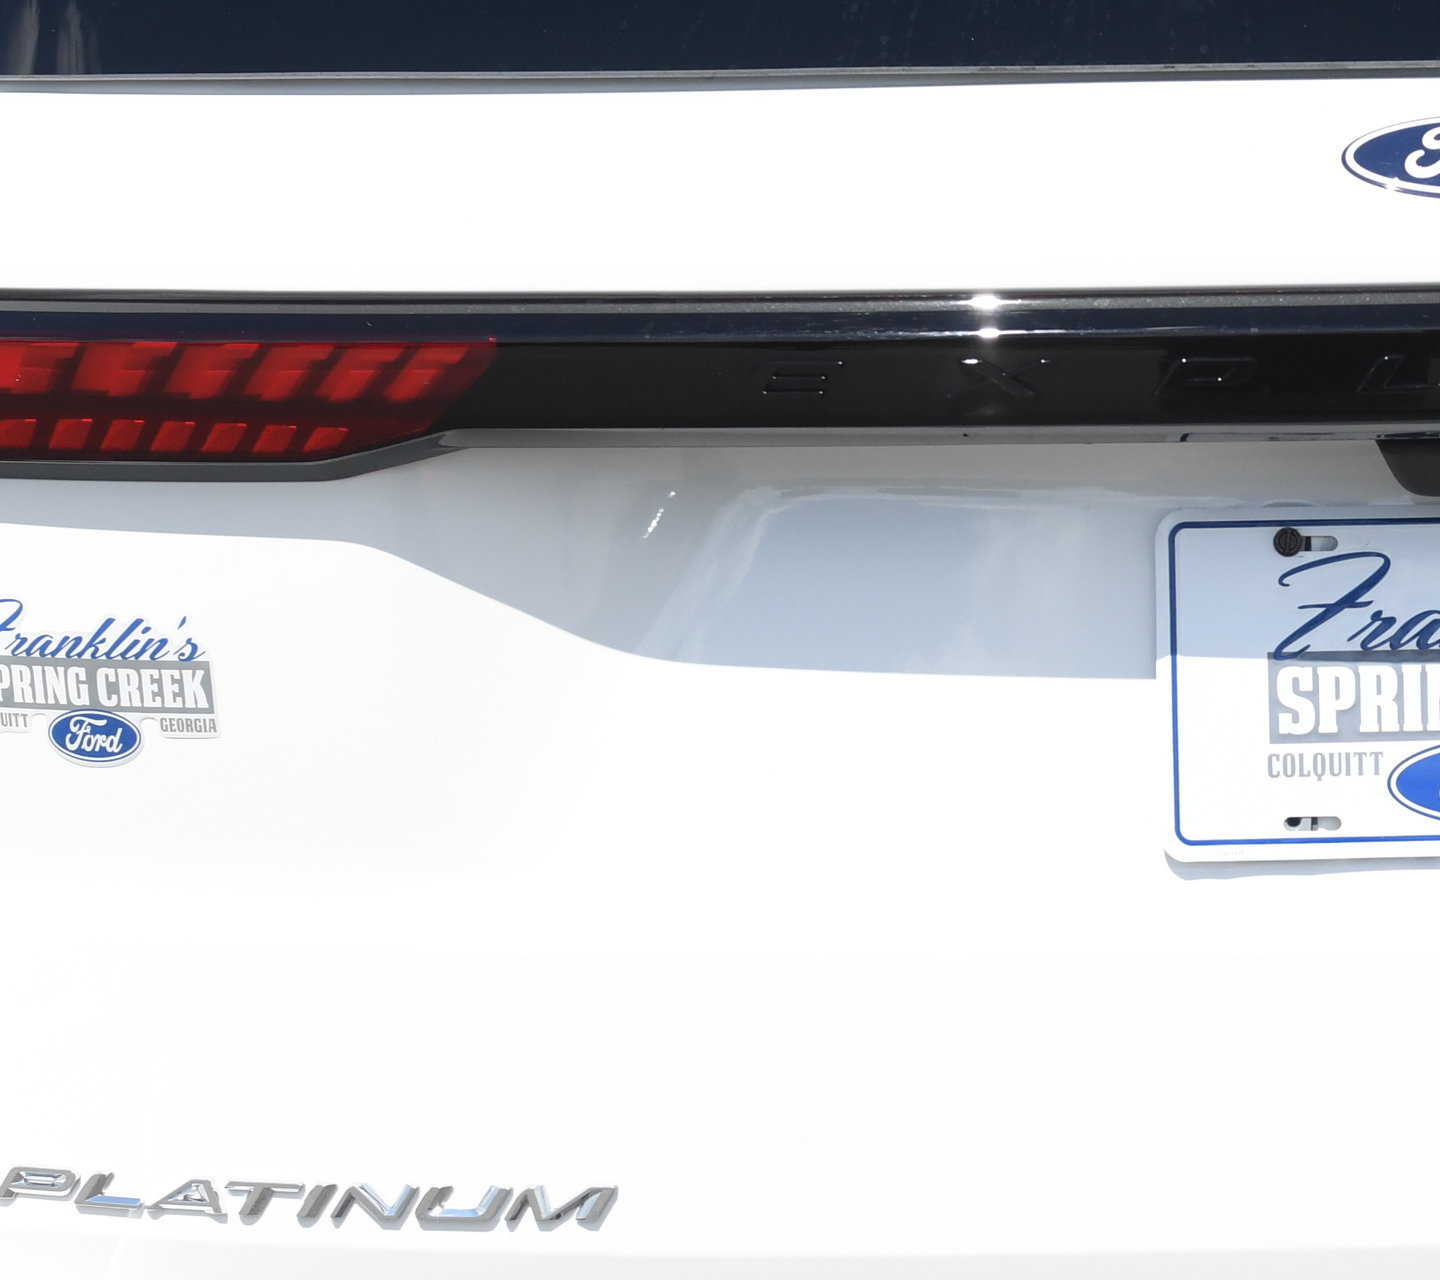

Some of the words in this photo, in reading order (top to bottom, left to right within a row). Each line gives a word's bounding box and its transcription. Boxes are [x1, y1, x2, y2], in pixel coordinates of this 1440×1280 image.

[96, 667, 209, 708] CREEK
[65, 716, 123, 753] Ford
[161, 717, 217, 734] GEORGIA
[1267, 751, 1384, 781] COLQUITT
